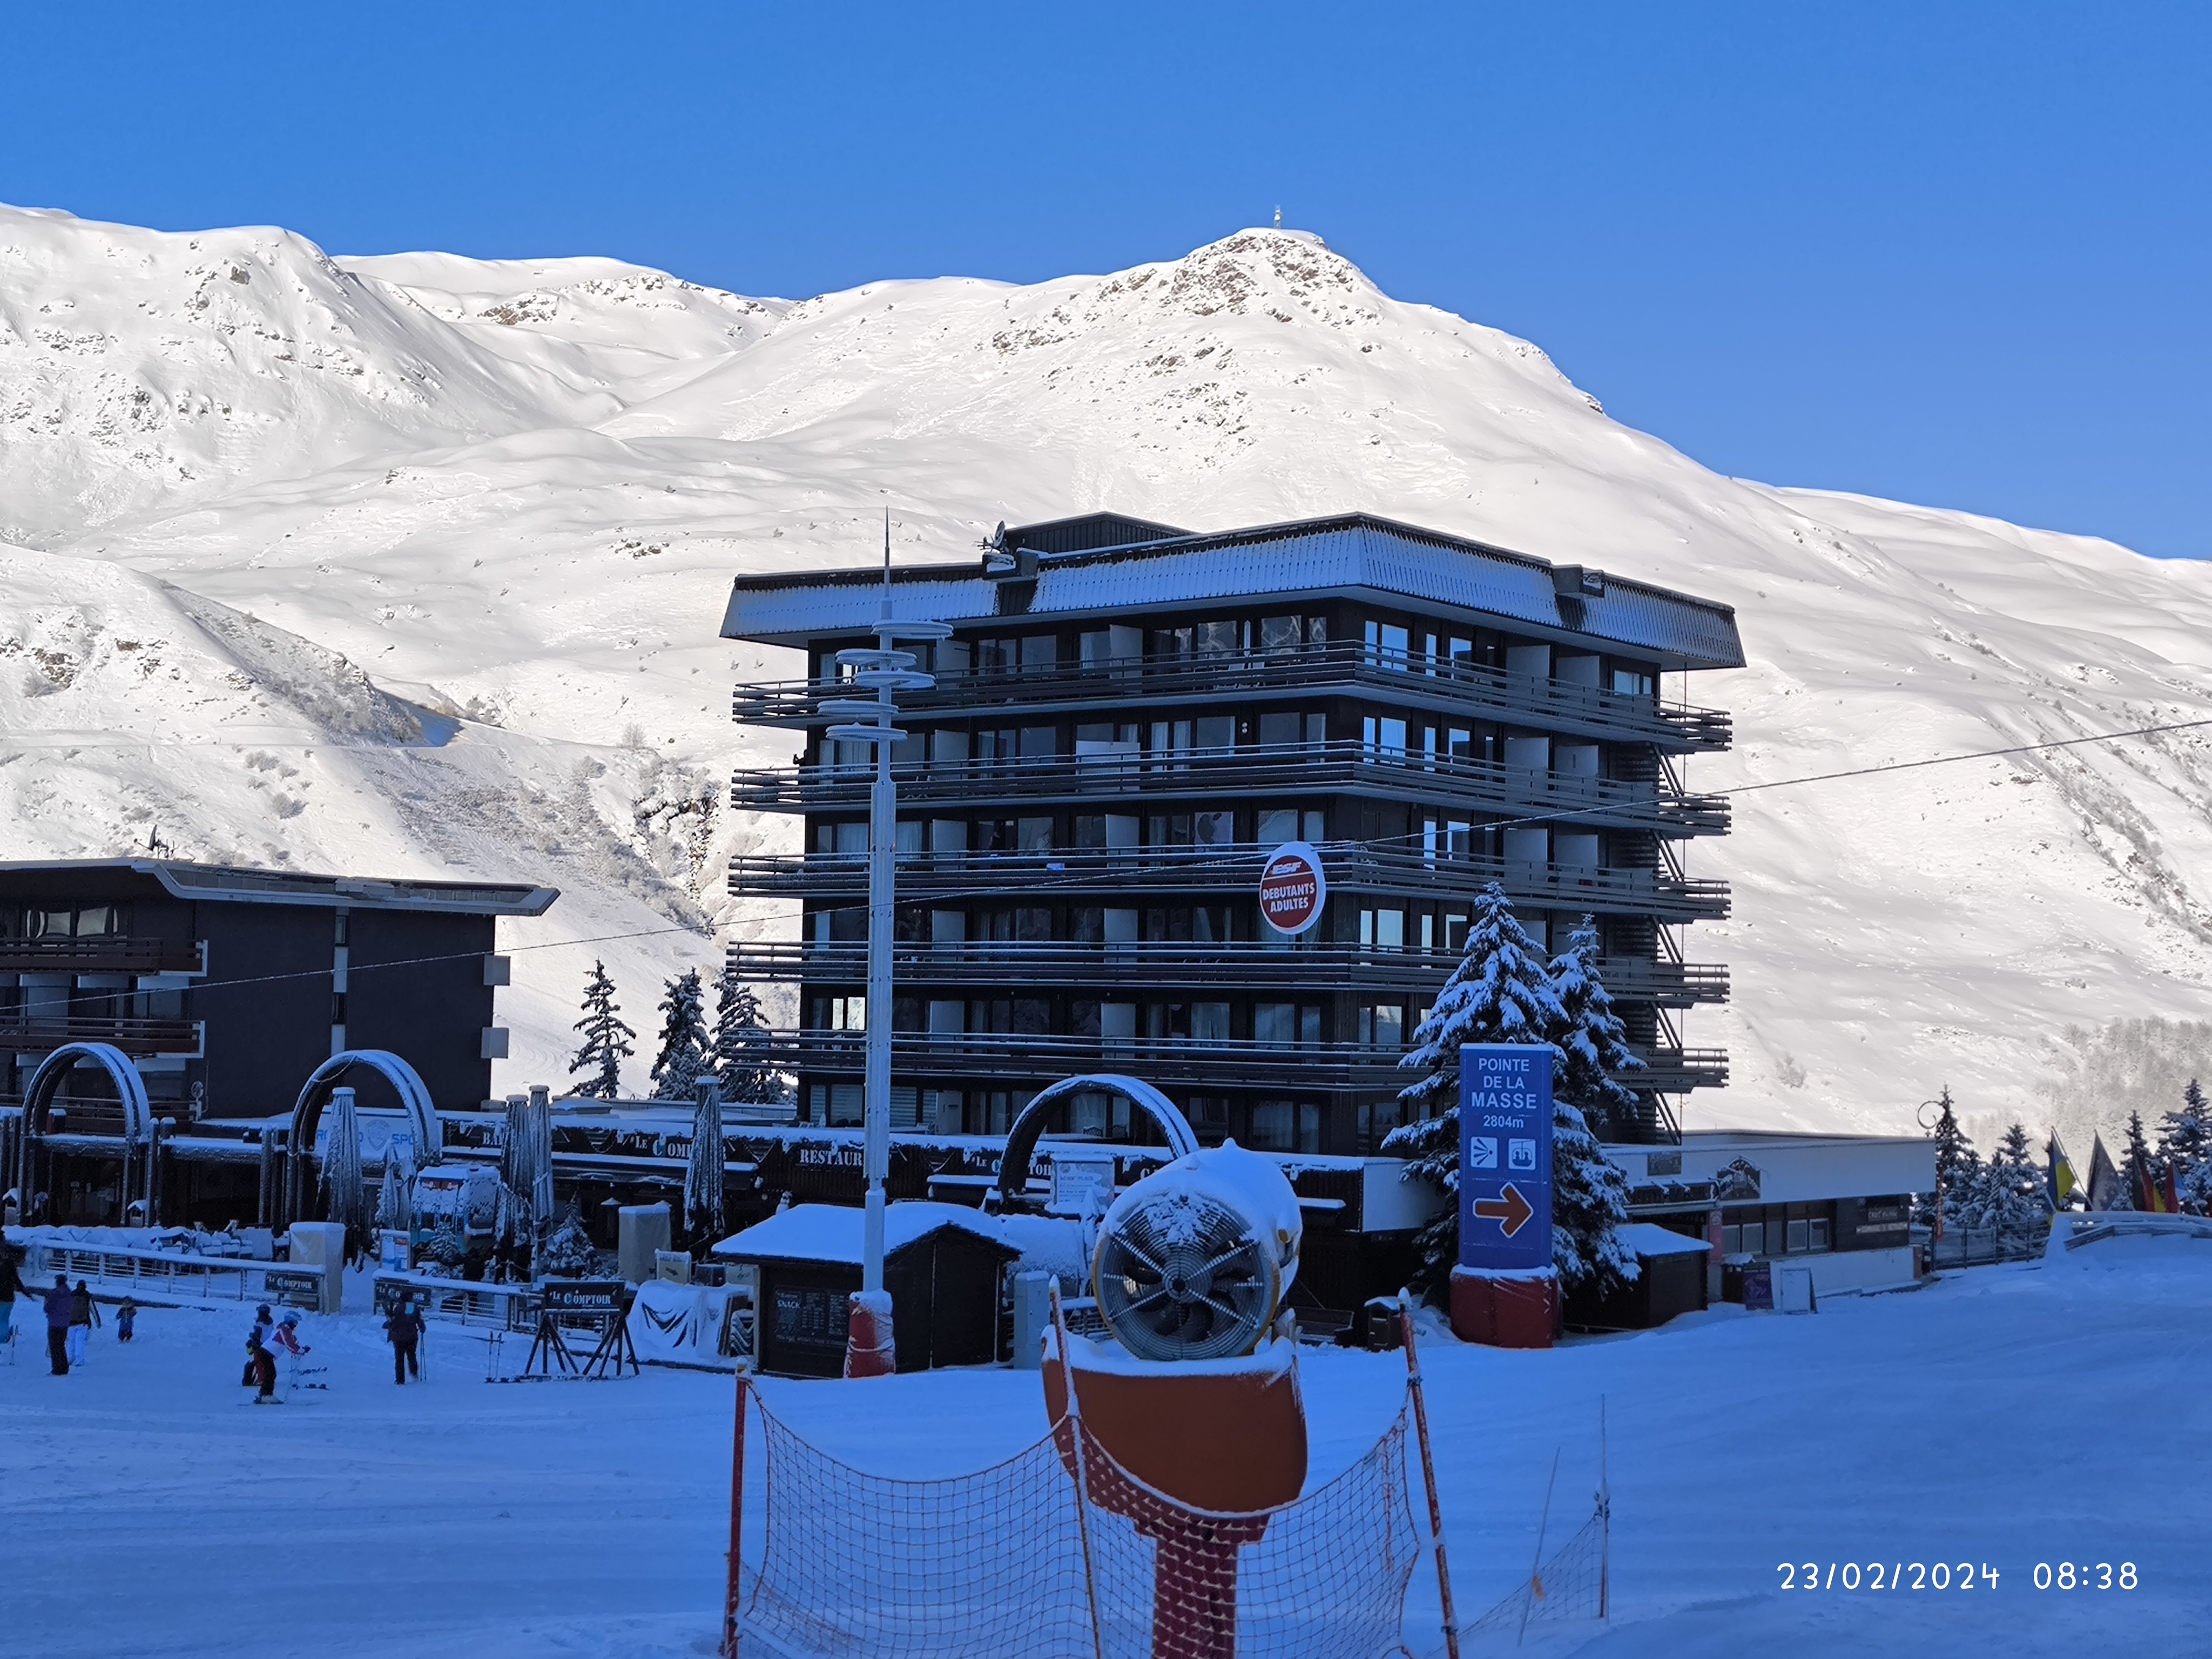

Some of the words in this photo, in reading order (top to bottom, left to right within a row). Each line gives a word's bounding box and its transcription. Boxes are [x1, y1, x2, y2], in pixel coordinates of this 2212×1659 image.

[1263, 882, 1316, 900] DEBUTANTS
[1270, 897, 1309, 913] ADULTES
[1479, 1058, 1530, 1071] POINTE
[1483, 1075, 1502, 1088] DE
[1506, 1076, 1525, 1089] LA
[1472, 1092, 1537, 1109] MASSE
[1483, 1115, 1524, 1128] 2804m
[564, 1293, 611, 1305] COMPTOIR
